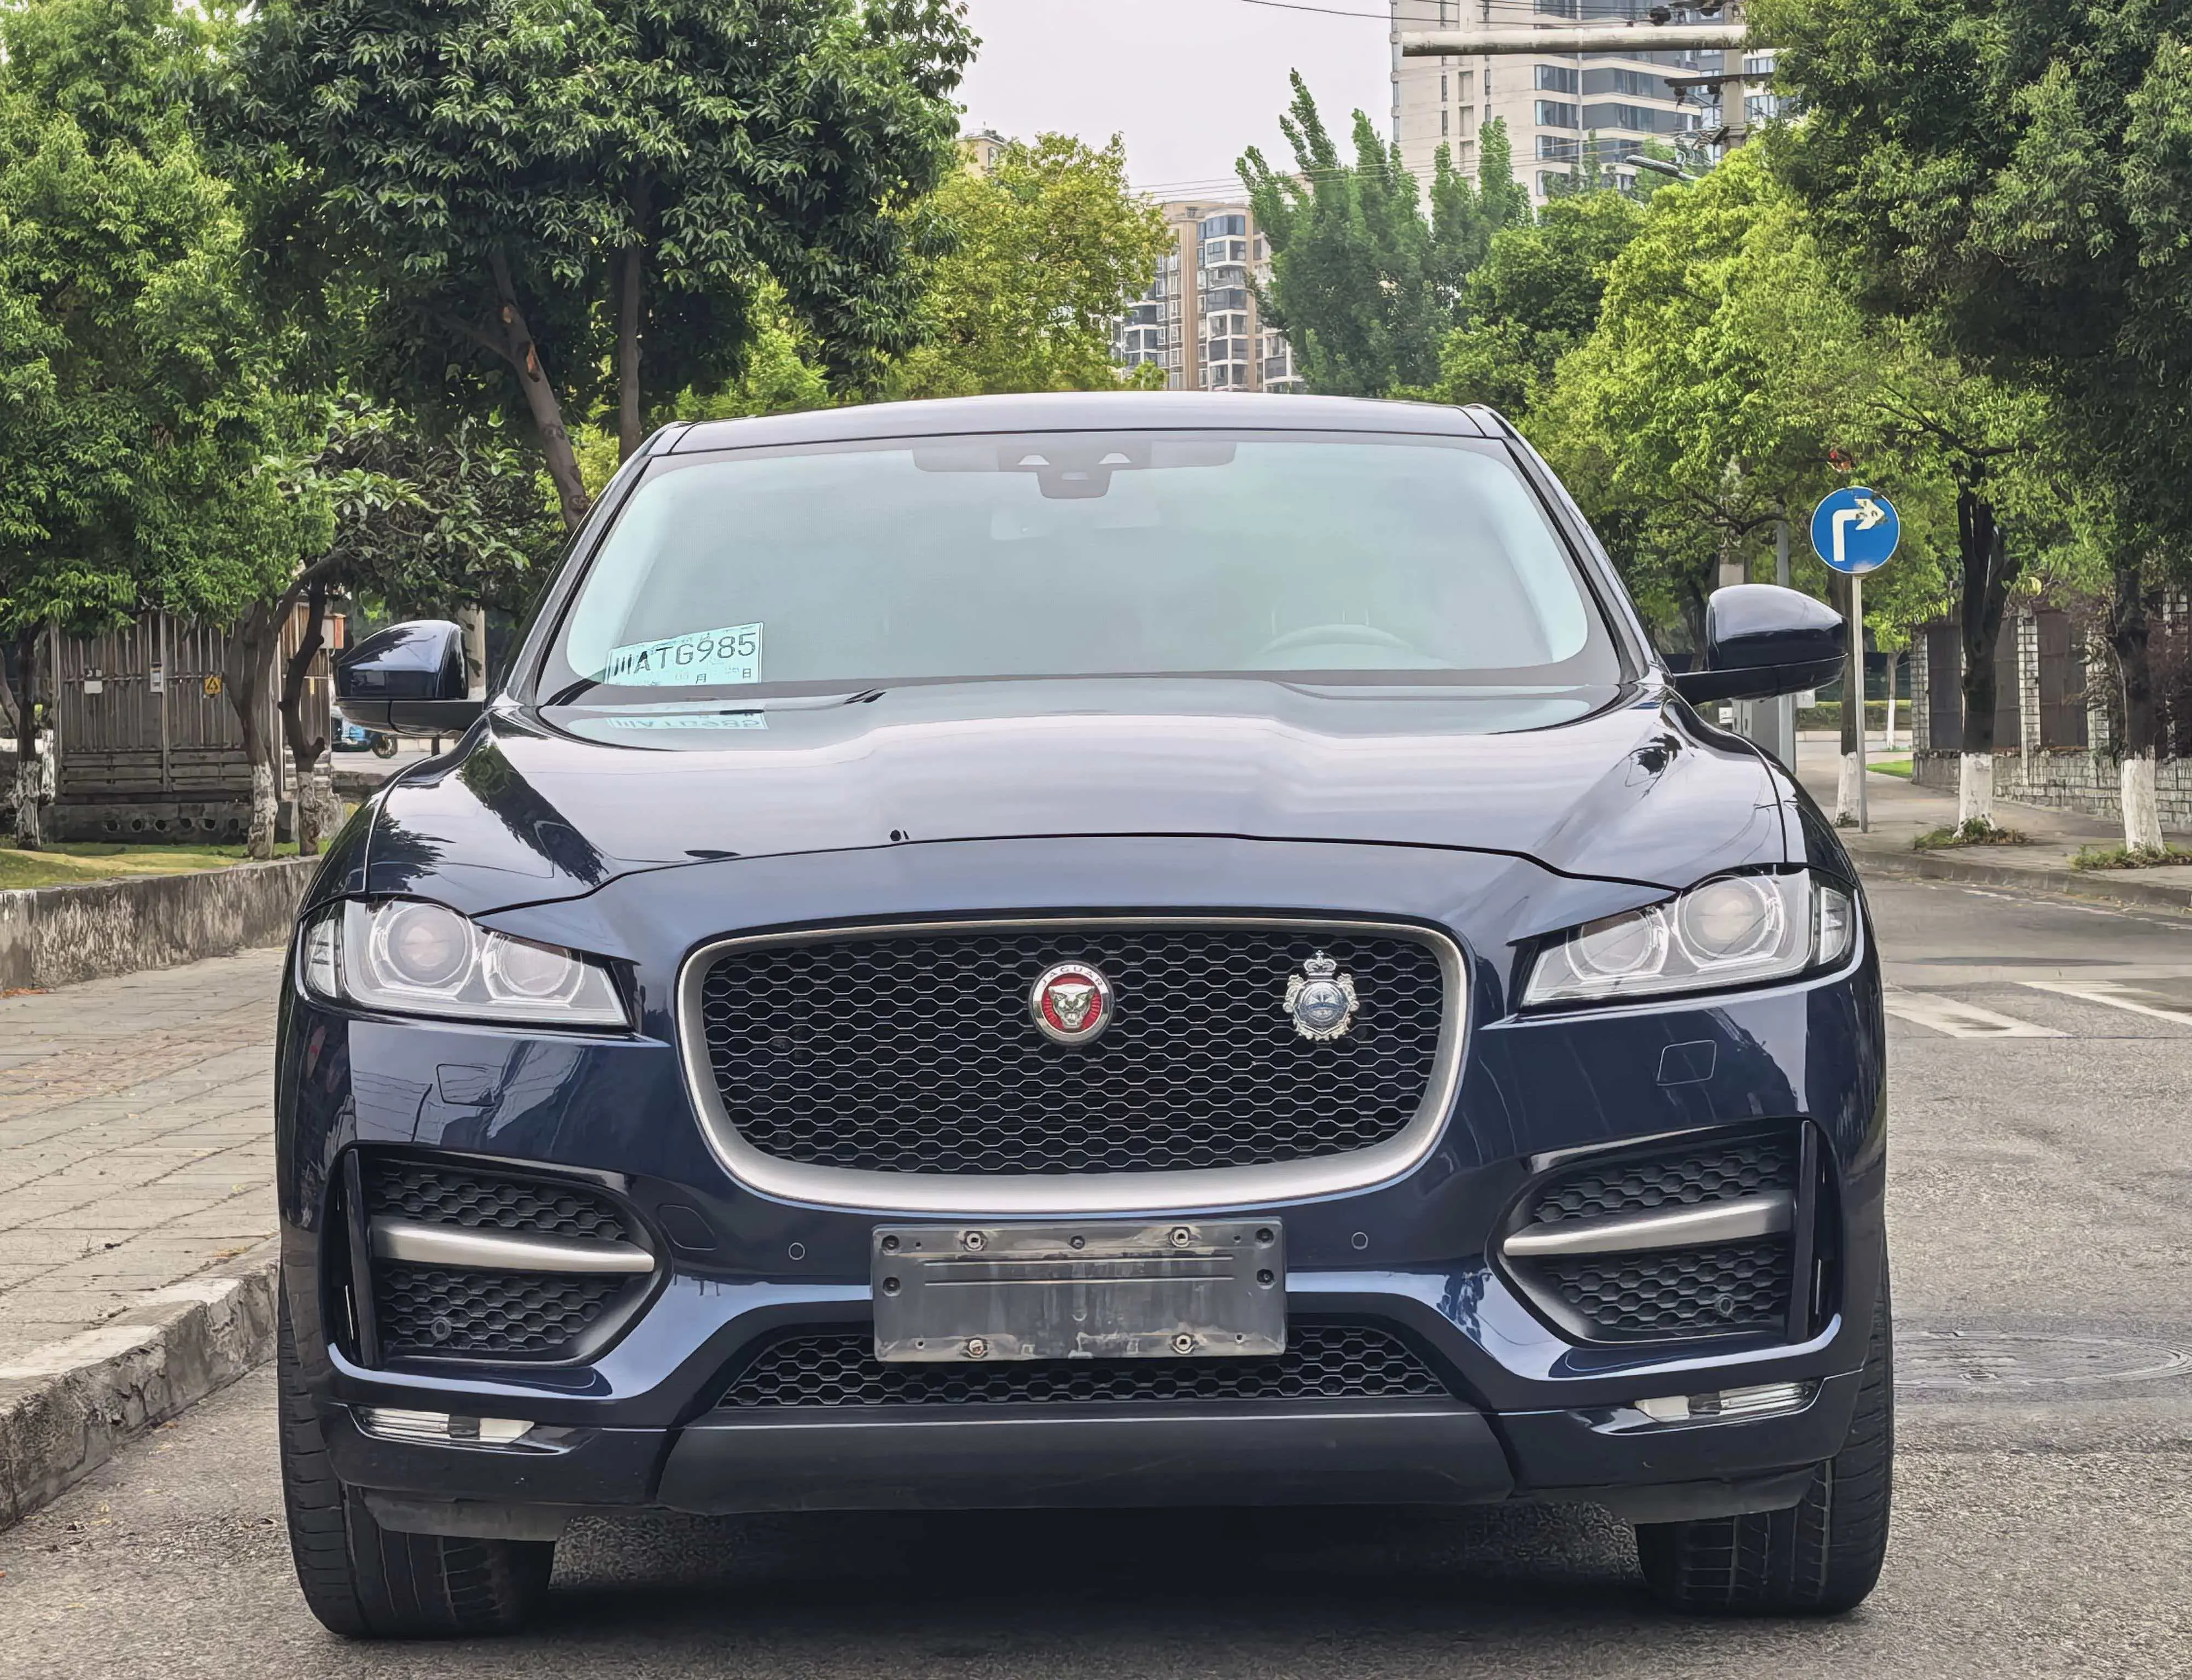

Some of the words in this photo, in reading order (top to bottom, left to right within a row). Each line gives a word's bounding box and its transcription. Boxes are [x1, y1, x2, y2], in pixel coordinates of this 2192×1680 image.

[696, 673, 707, 684] 月
[743, 668, 751, 679] 日
[1042, 966, 1103, 987] JAGUAR
